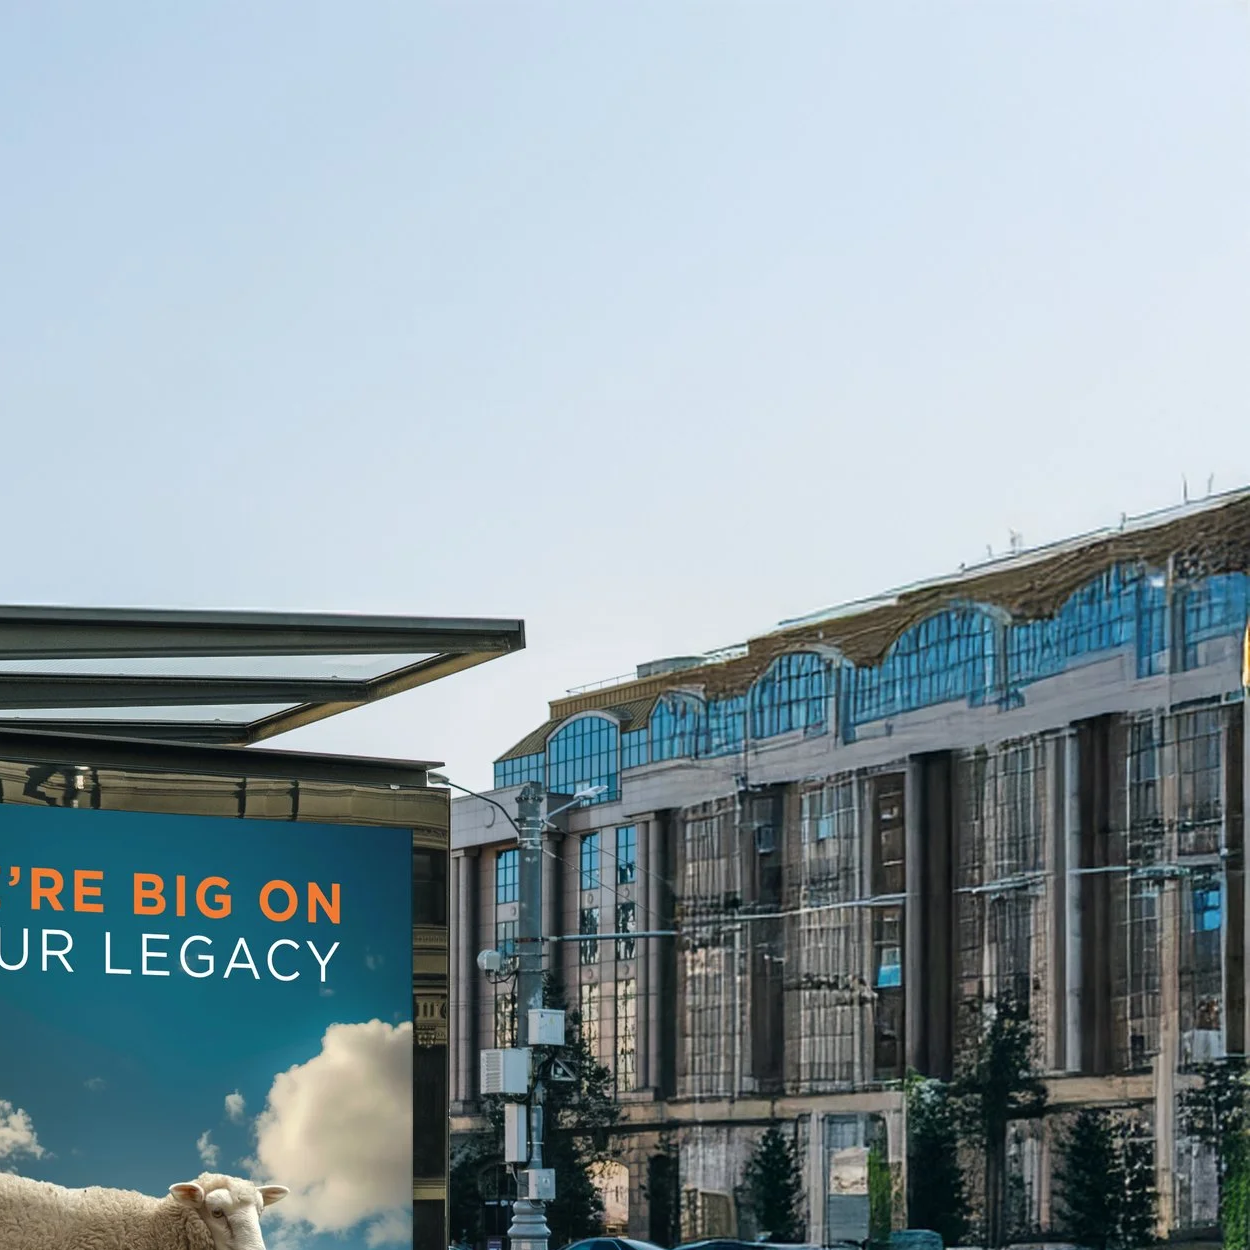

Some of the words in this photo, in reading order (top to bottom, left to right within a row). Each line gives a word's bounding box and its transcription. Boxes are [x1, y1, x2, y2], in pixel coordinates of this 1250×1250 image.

[134, 873, 231, 918] BIG
[260, 880, 340, 924] ON
[106, 932, 339, 982] LEGACY
